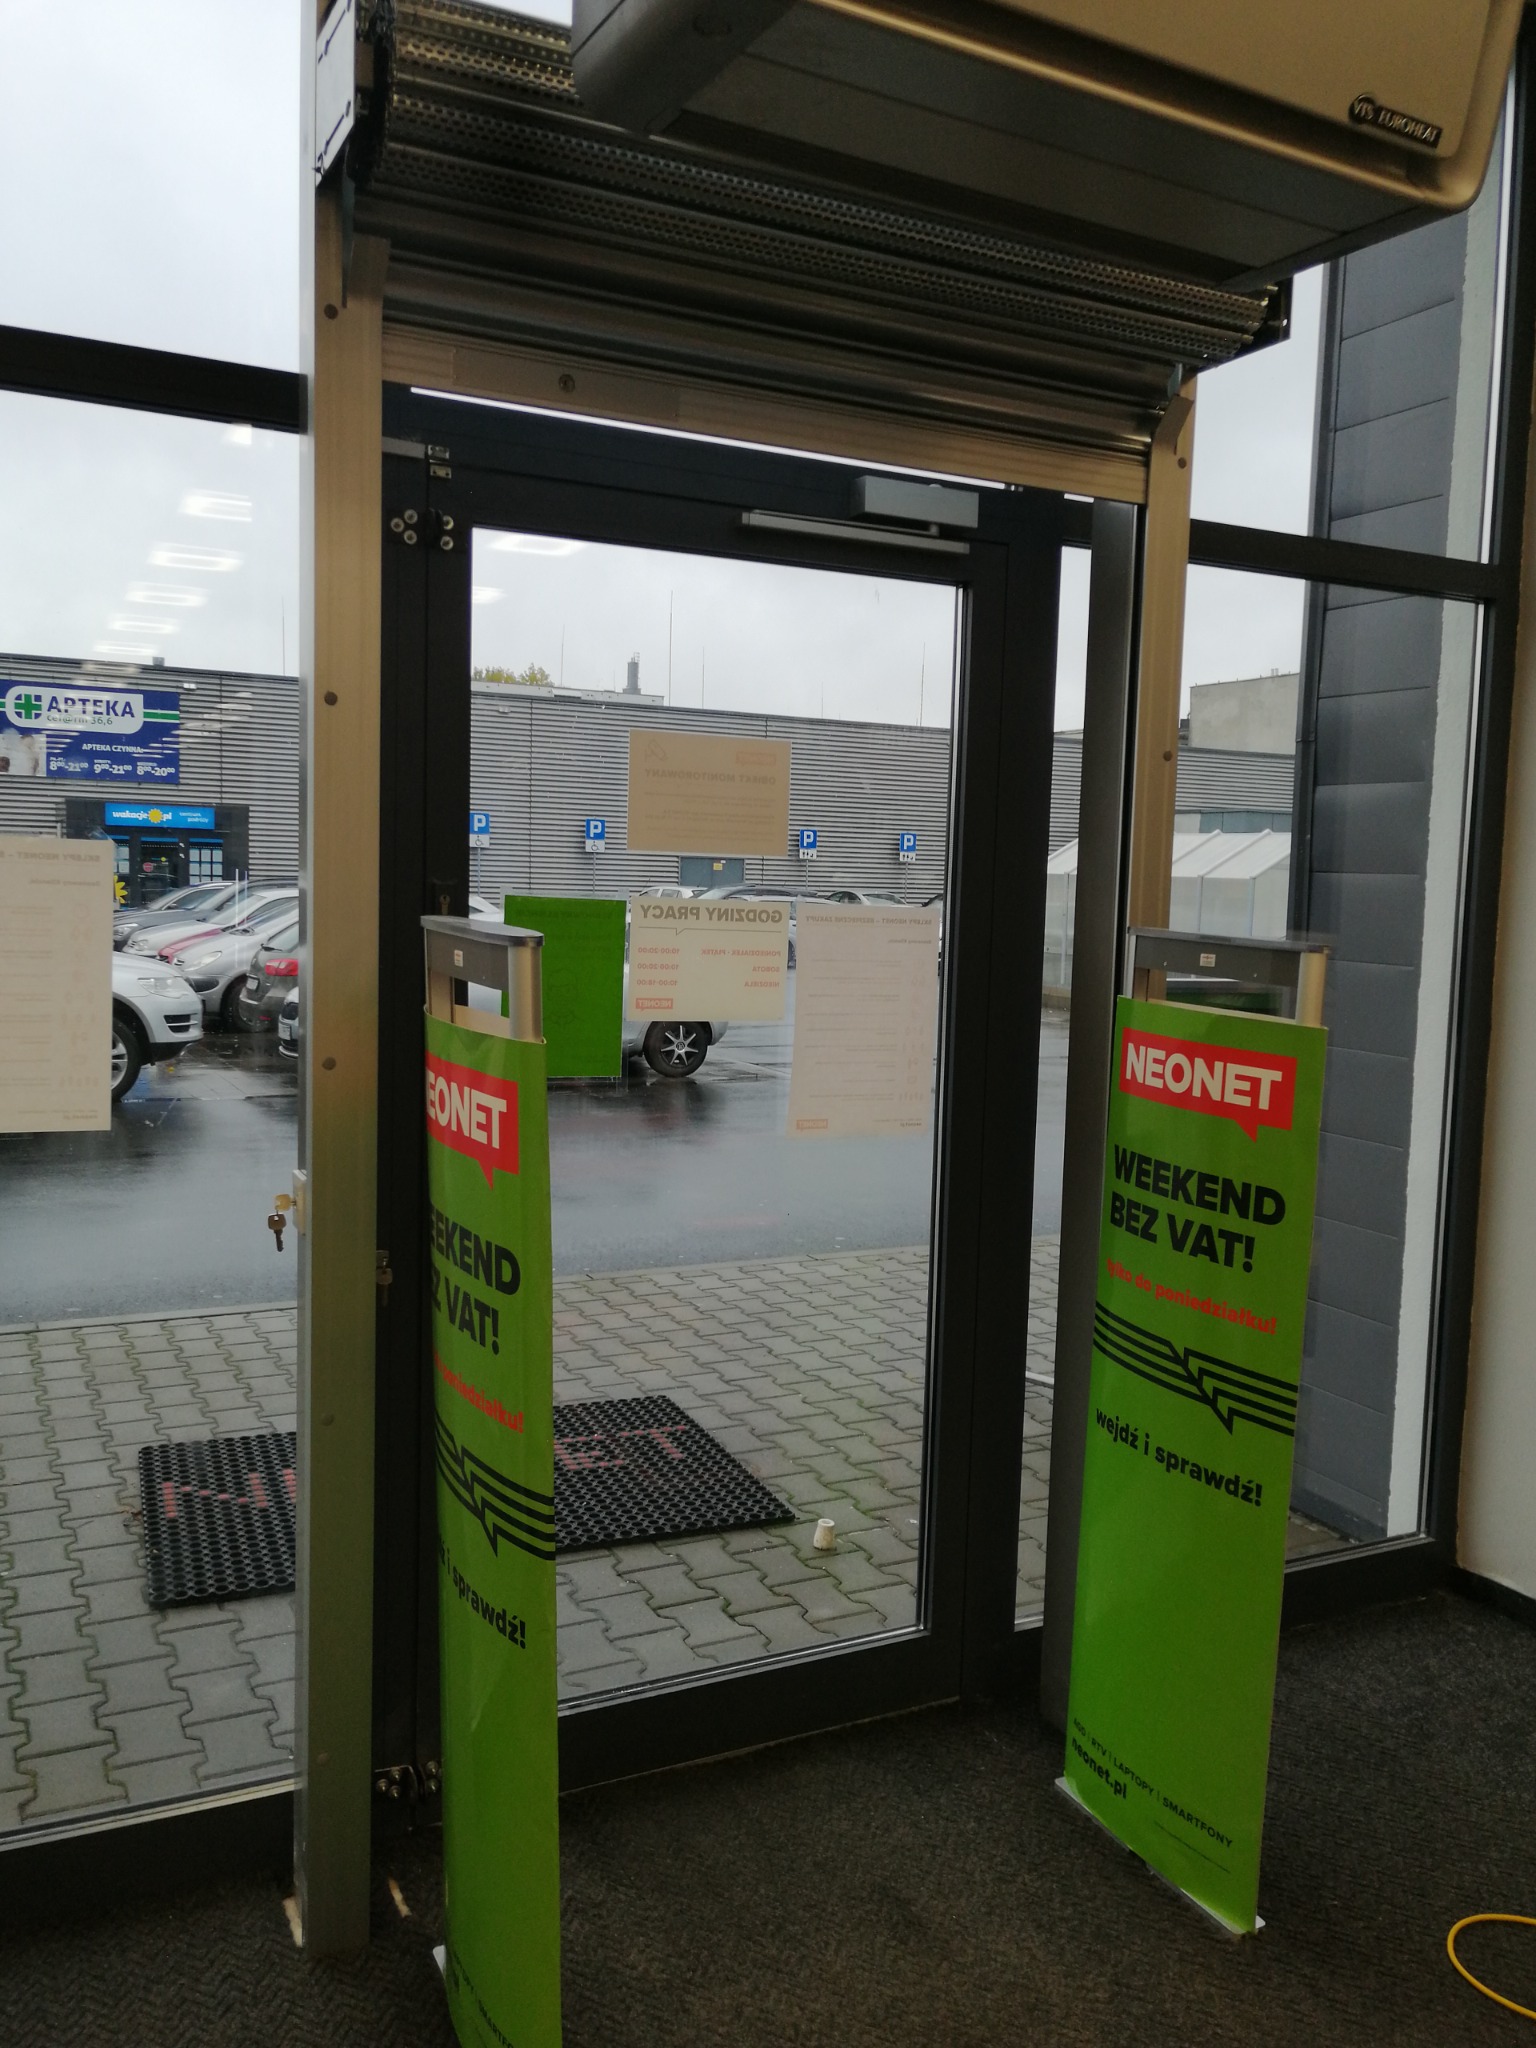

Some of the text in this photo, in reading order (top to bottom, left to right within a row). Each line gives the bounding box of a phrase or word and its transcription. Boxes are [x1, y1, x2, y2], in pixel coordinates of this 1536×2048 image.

[1353, 100, 1439, 142] VTS EUROHEAT
[47, 695, 135, 719] APTEKA
[90, 716, 113, 726] 36,6
[82, 743, 111, 752] APTEKA
[473, 814, 486, 831] P
[590, 821, 602, 838] P
[803, 831, 814, 847] P
[904, 835, 914, 850] P
[425, 1067, 508, 1150] EONET
[1125, 1042, 1283, 1111] NEONET
[1113, 1144, 1287, 1226] WEEKEND
[1109, 1191, 1256, 1274] BEZ VAT!
[444, 1276, 500, 1356] VAT!
[1107, 1257, 1278, 1336] tylko do poniedziałku!
[1096, 1407, 1264, 1508] wejdź i sprawdź!
[452, 1566, 527, 1650] sprawdź!
[1071, 1736, 1129, 1801] neonet.pl
[1113, 1756, 1154, 1798] LAPTOPY
[1162, 1796, 1234, 1849] SMARTFONY
